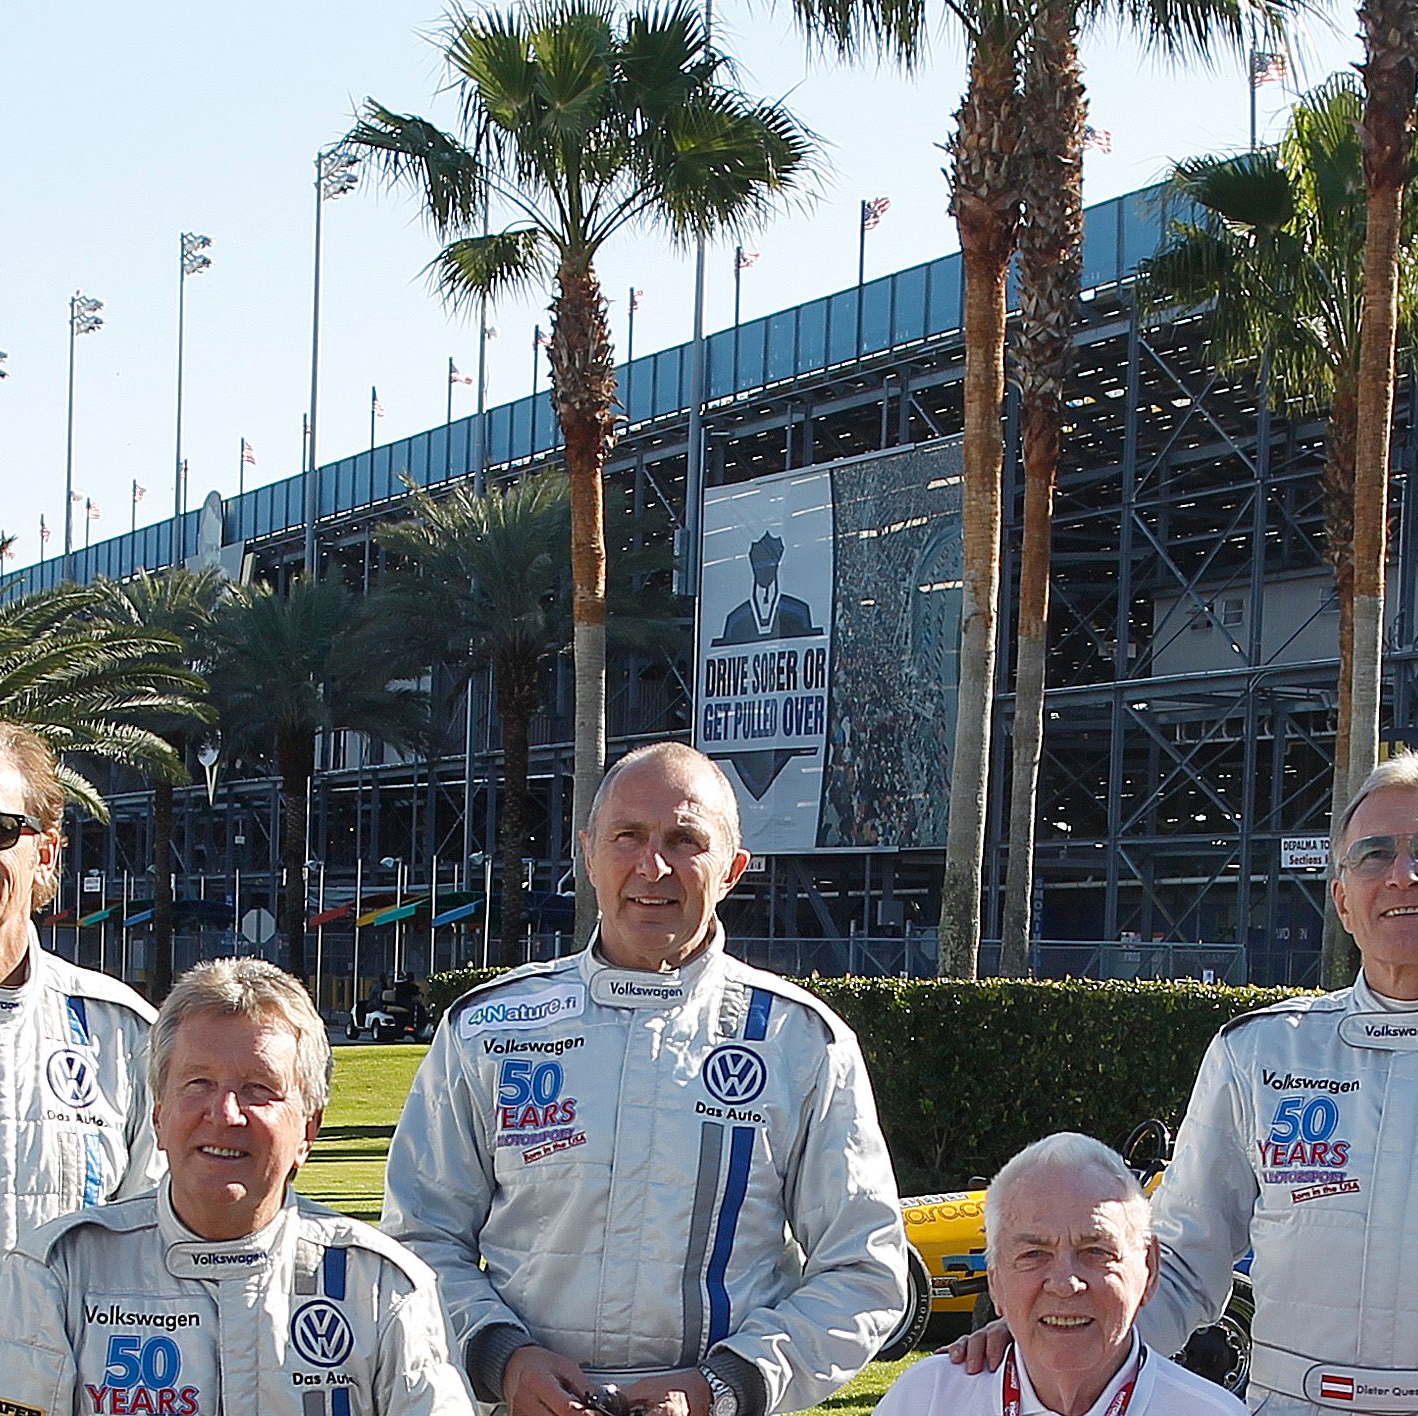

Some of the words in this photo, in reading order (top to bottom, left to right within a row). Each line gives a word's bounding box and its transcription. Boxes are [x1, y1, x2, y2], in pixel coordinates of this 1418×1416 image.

[705, 655, 749, 698] DRIVE
[752, 650, 798, 695] SOBER
[803, 648, 827, 689] OR
[703, 703, 731, 741] GET
[733, 698, 778, 740] PULLED
[783, 695, 824, 736] OVER
[1283, 840, 1318, 851] DEPALMA
[610, 982, 683, 999] Volkswagen
[468, 996, 577, 1026] 4Nature.fi
[483, 1035, 585, 1056] Volkswagen
[498, 1059, 564, 1107] 50
[1262, 1069, 1360, 1094] Volkswagen
[47, 1110, 70, 1123] Das
[496, 1097, 577, 1130] EARS
[695, 1101, 723, 1120] Das
[726, 1106, 766, 1124] Auto.
[1269, 1095, 1339, 1145] 50
[1256, 1139, 1351, 1168] YEARS
[1339, 1181, 1360, 1193] USA
[84, 1305, 200, 1332] Volkswagen
[103, 1334, 181, 1391] 50
[292, 1372, 322, 1386] Das
[1356, 1385, 1390, 1396] Dieter
